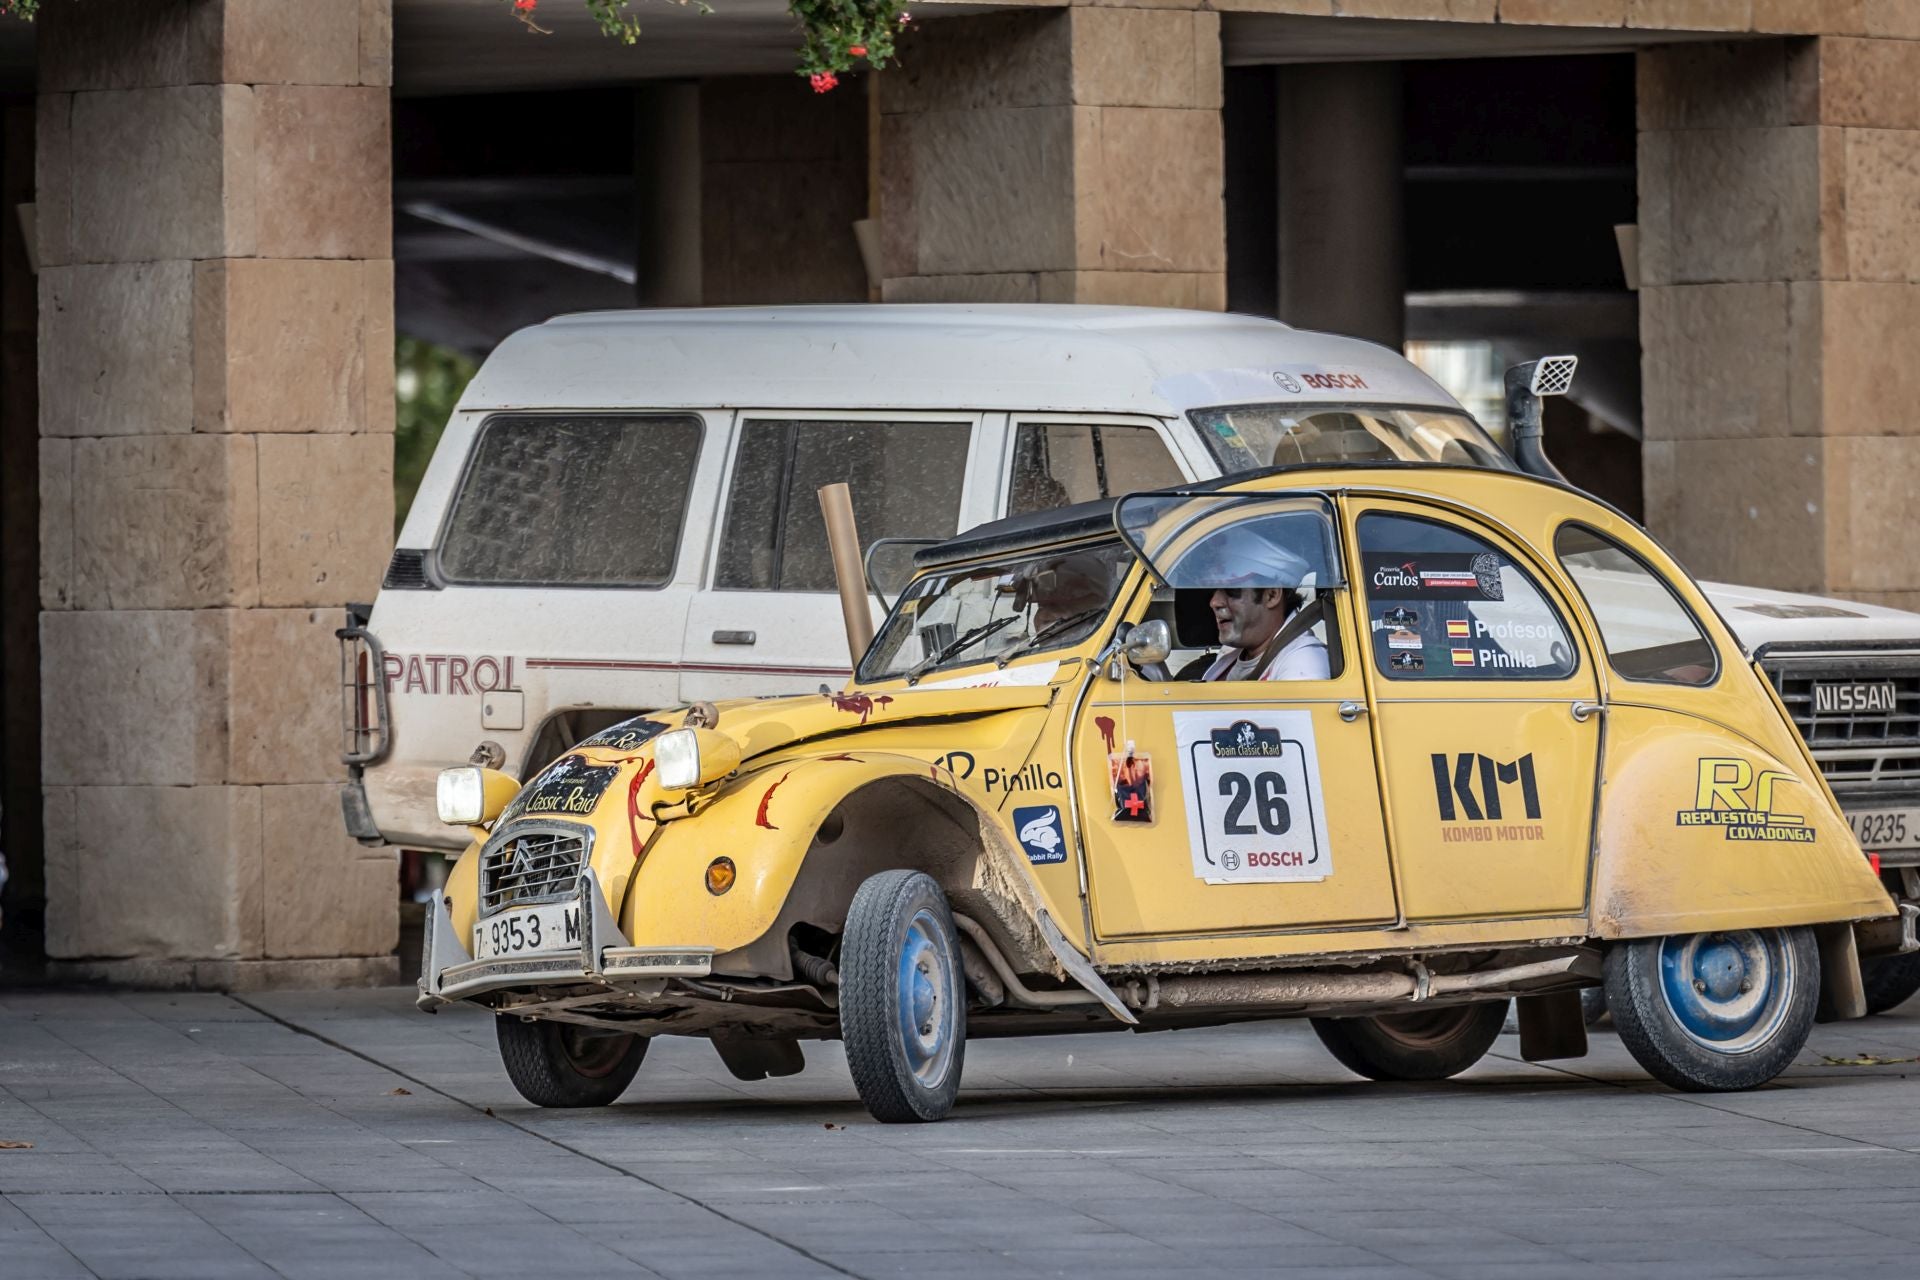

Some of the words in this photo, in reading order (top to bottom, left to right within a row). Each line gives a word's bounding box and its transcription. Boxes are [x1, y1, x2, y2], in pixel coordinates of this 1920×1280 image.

[1301, 373, 1369, 389] BOSCH
[1374, 572, 1419, 587] Carlos
[1474, 620, 1554, 639] Profesor
[1479, 649, 1537, 668] Pinilla
[382, 653, 521, 695] PATROL
[1815, 685, 1896, 711] NISSAN
[1214, 741, 1237, 757] Spain
[1238, 744, 1261, 756] Classic
[1261, 741, 1280, 755] Raid
[984, 763, 1063, 793] Pinilla
[1431, 752, 1542, 821] KM
[525, 787, 563, 813] Classic
[561, 786, 600, 813] Raid
[1218, 771, 1292, 836] 26
[1680, 811, 1767, 825] REPUESTOS
[1442, 826, 1492, 842] KOMBO
[1496, 825, 1545, 841] MOTOR
[1728, 826, 1814, 841] COVADONGA
[1861, 813, 1907, 844] 8235
[1247, 851, 1303, 868] BOSCH
[491, 914, 542, 956] 9353
[564, 907, 581, 943] M
